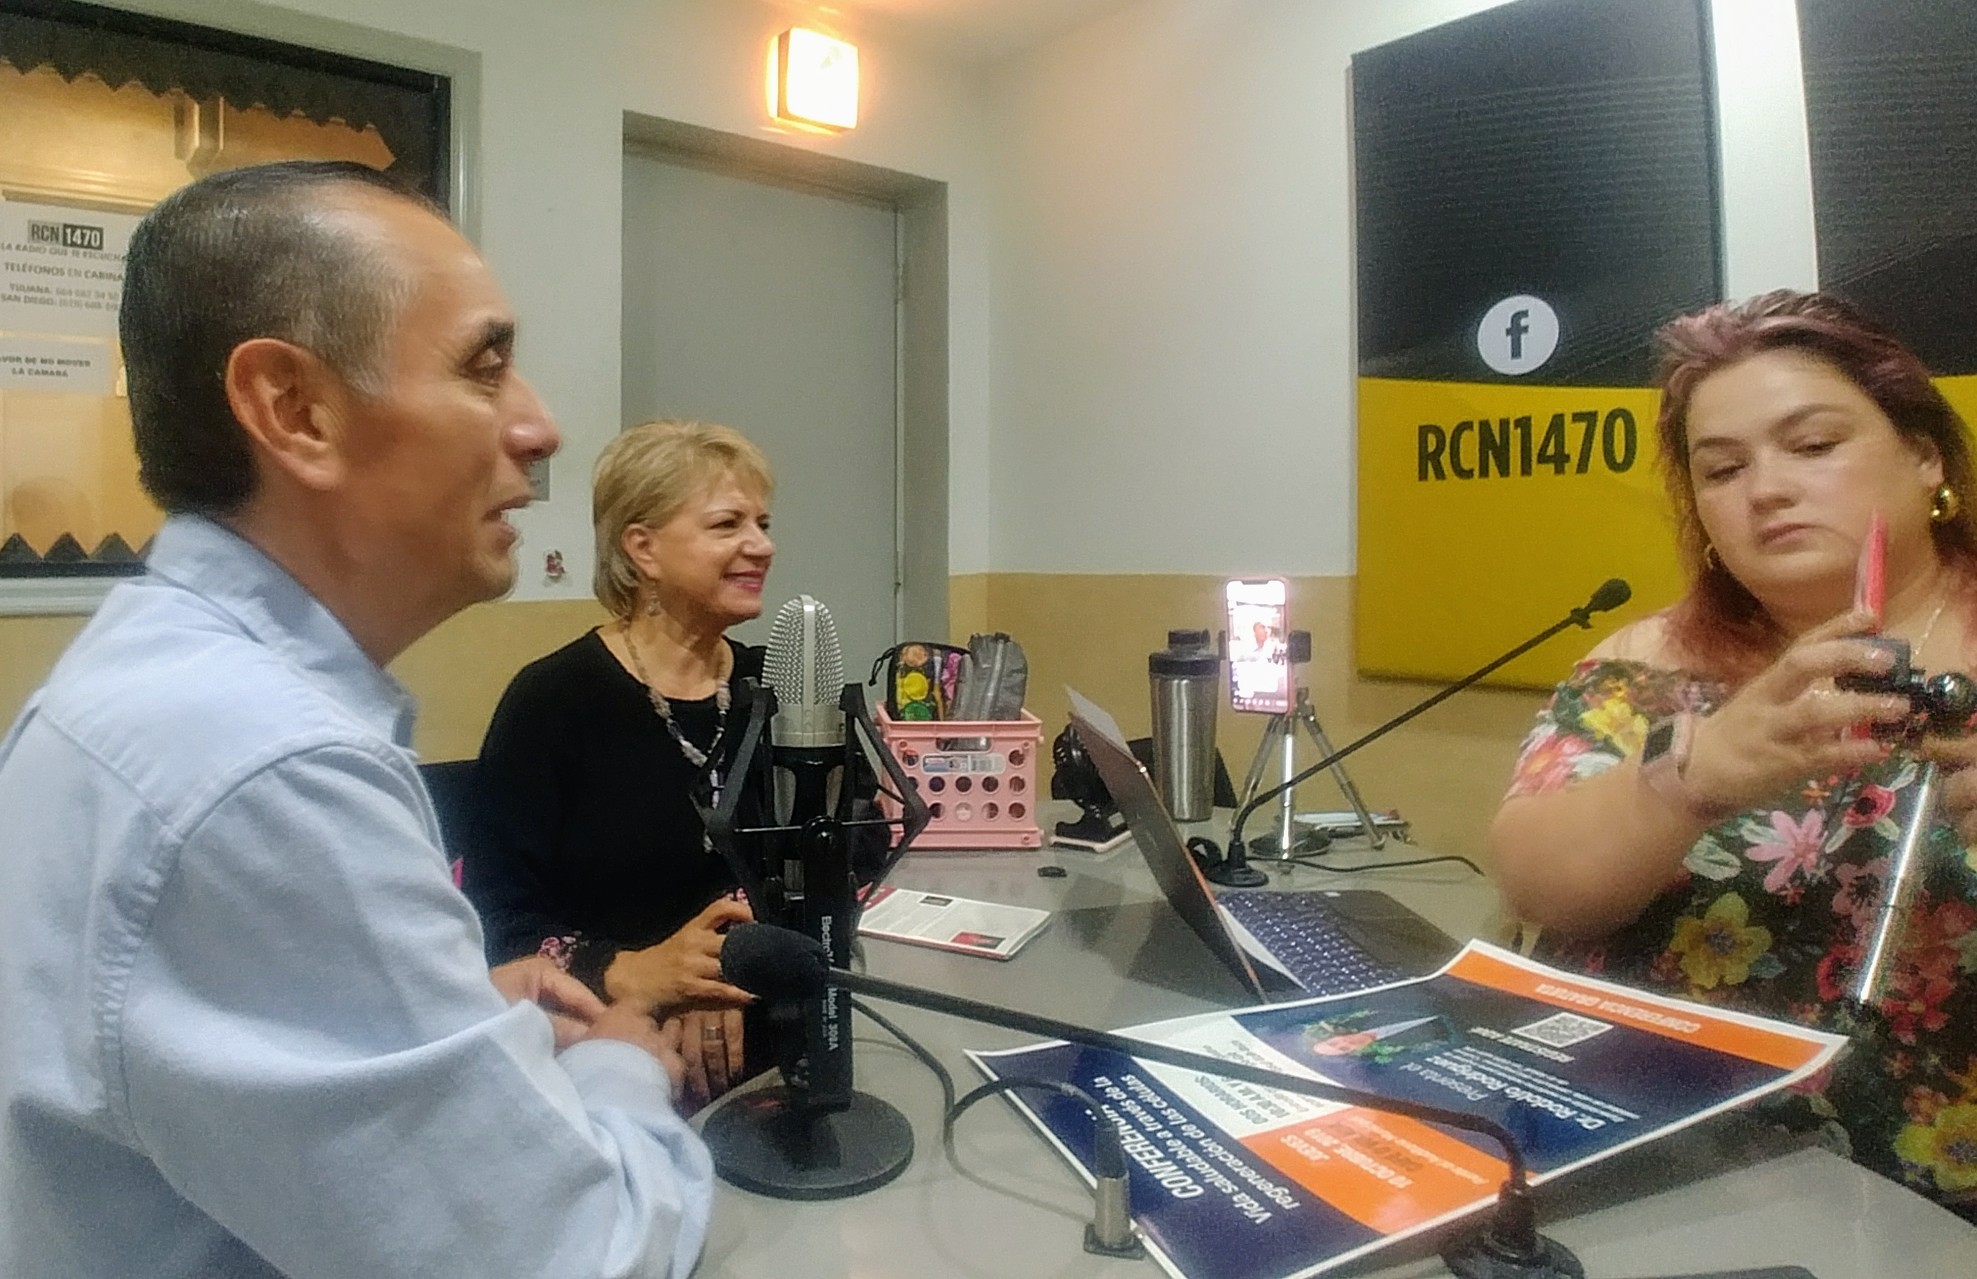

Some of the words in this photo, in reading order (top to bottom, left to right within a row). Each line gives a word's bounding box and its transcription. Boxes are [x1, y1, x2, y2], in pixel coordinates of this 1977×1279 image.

[1, 243, 13, 251] LA
[15, 244, 47, 255] RADIO
[32, 224, 59, 241] RCN
[65, 228, 100, 247] 1470
[5, 262, 65, 277] TELÉFONOS
[1417, 407, 1638, 482] RCN1470
[828, 988, 838, 1019] Model
[1093, 1075, 1112, 1088] la
[1105, 1084, 1128, 1102] de
[1120, 1073, 1169, 1110] células
[1418, 1069, 1490, 1101] Presenta
[1120, 1098, 1164, 1132] través
[1160, 1107, 1188, 1126] las
[1238, 1108, 1270, 1125] DOS
[1503, 1085, 1579, 1119] Rodolfo
[1180, 1122, 1206, 1140] de
[1573, 1113, 1608, 1130] Dr.
[1279, 1133, 1330, 1162] JUEVES
[1166, 1137, 1239, 1195] saludable
[1199, 1137, 1301, 1210] regeneración
[1232, 1193, 1273, 1225] Vida
